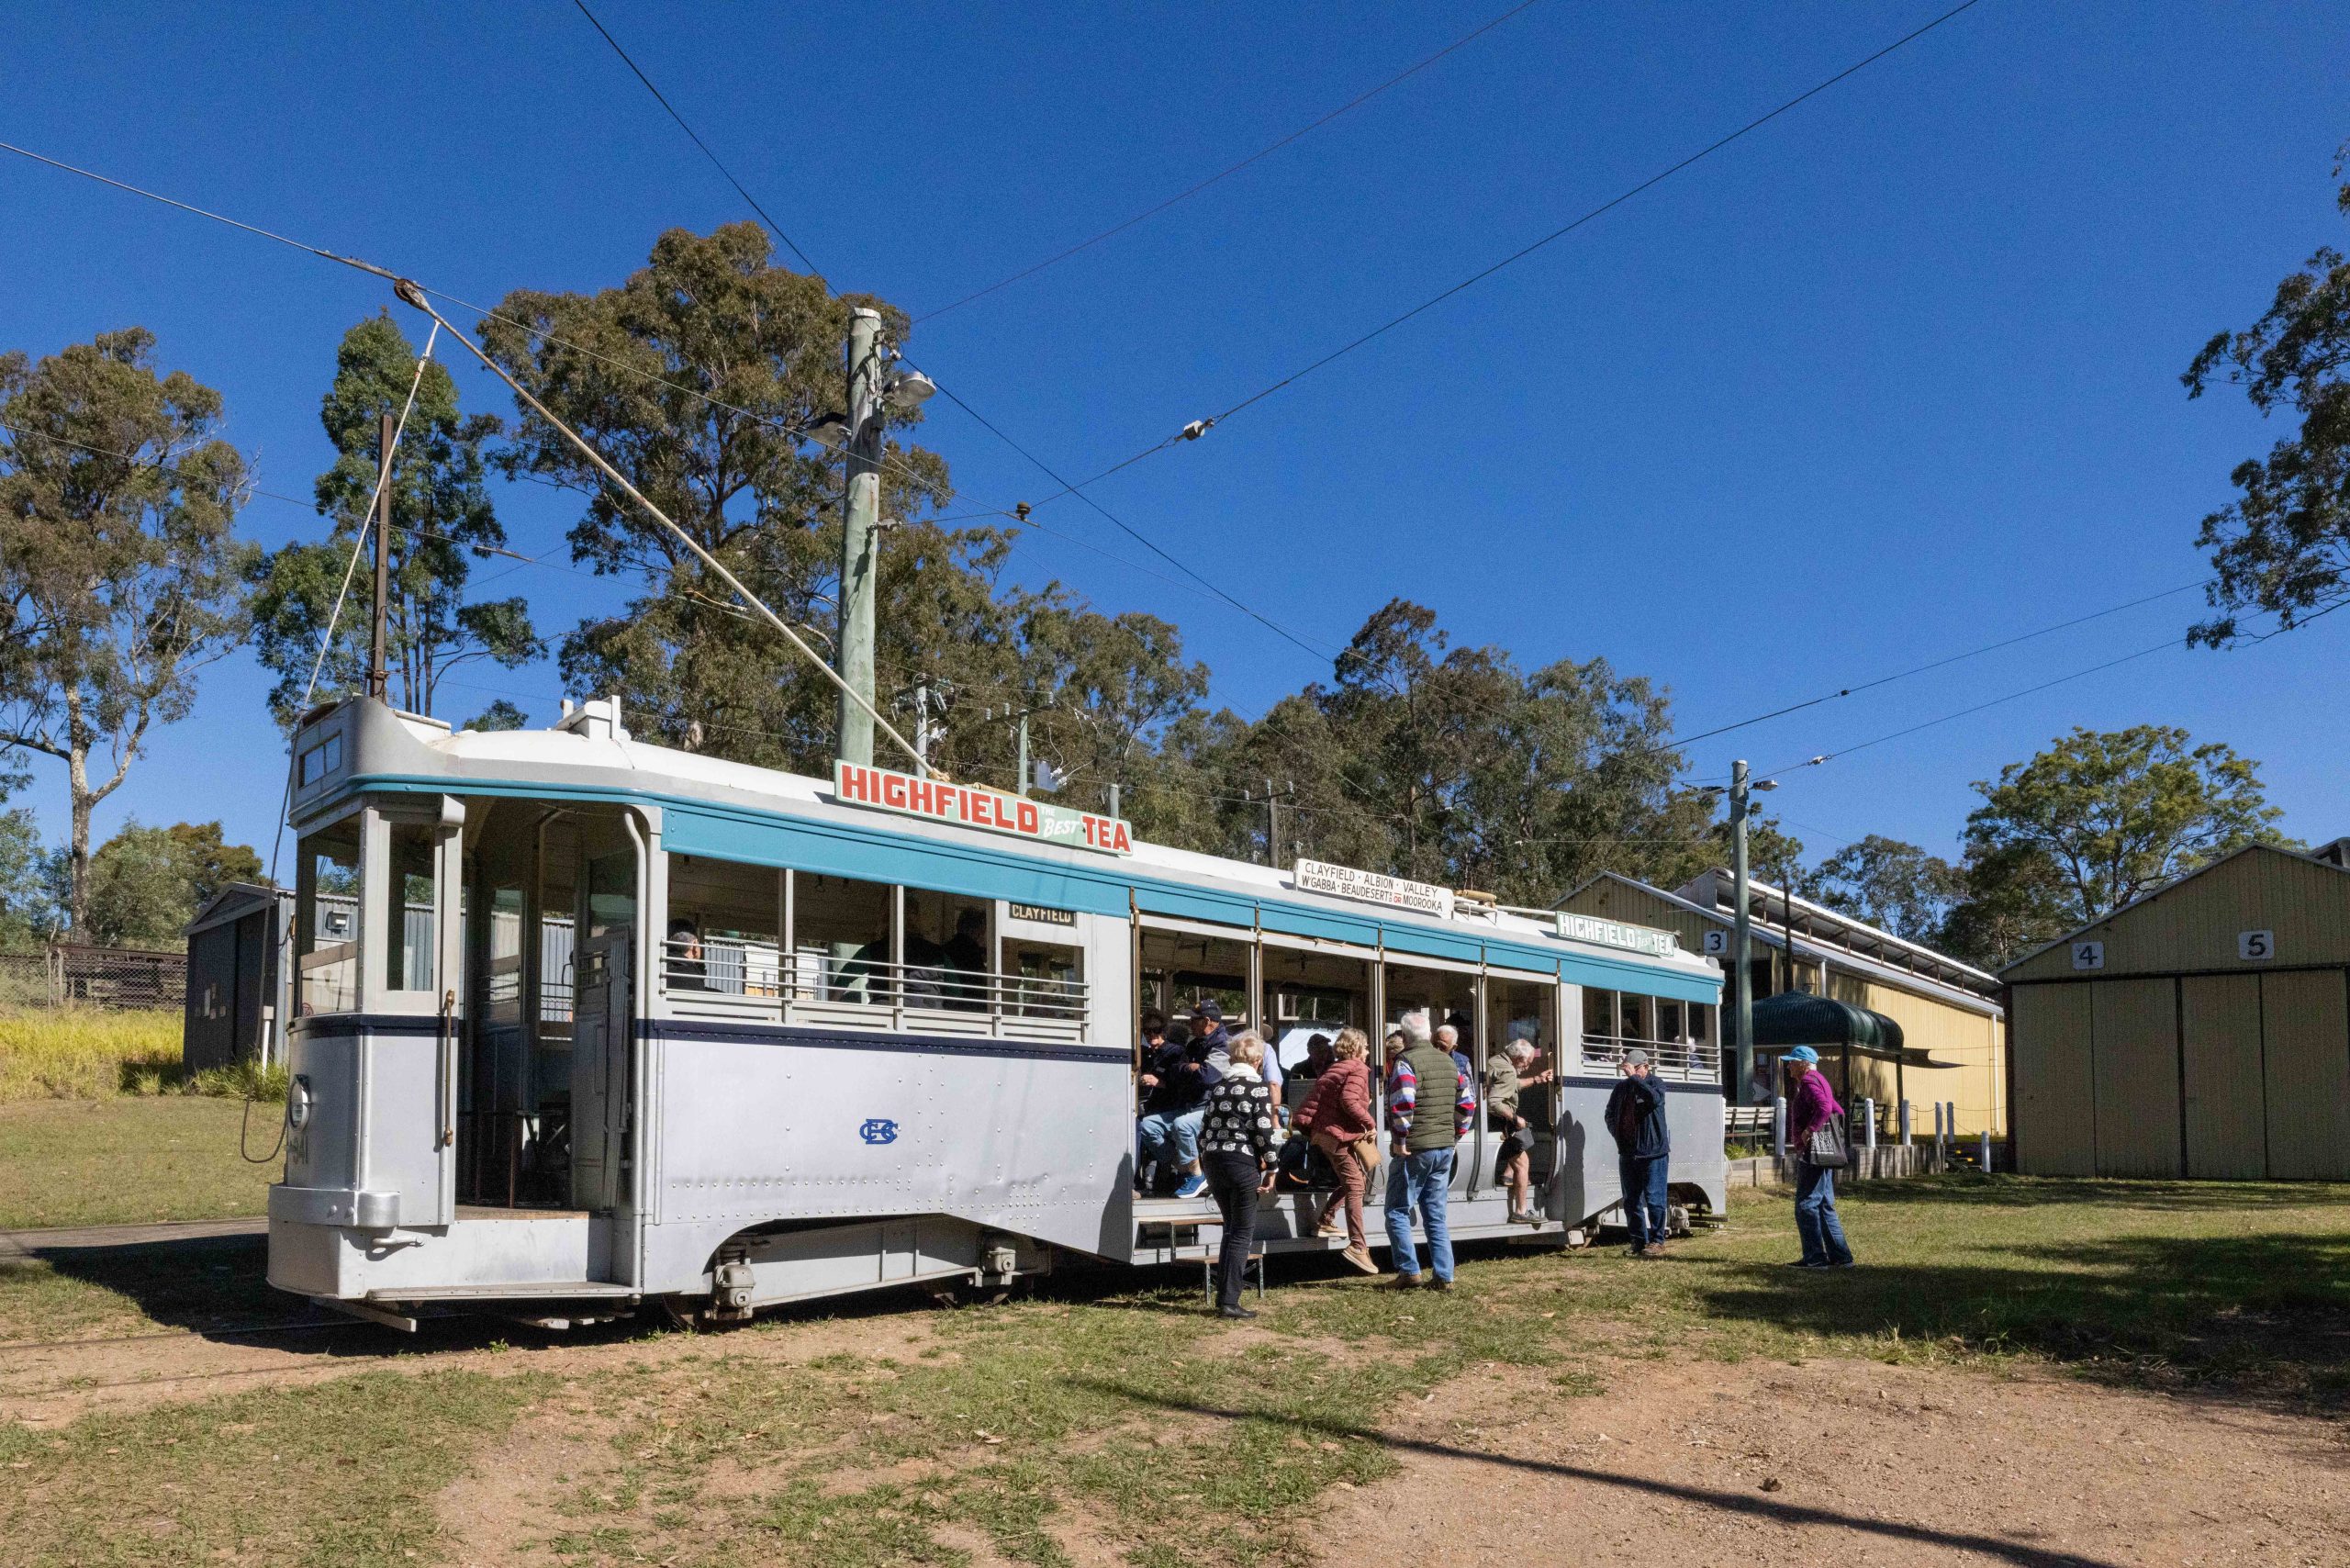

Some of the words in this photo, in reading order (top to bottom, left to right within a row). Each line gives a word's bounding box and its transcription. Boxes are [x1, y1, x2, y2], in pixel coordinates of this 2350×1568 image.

[840, 764, 1039, 834] HIGHFIELD
[1081, 814, 1132, 853] TEA
[1041, 806, 1056, 816] THE
[1044, 817, 1080, 837] BEST
[1305, 862, 1355, 881] CLAYFIELD
[1364, 874, 1393, 891] ALBION
[1403, 881, 1438, 898] VALLEY
[1341, 882, 1389, 902] BEAUDESERT
[1403, 894, 1443, 912] MOOROOKA
[1013, 904, 1071, 924] CLAYFIELD
[1559, 913, 1636, 948] HIGHFIELD
[1651, 933, 1673, 956] TEA
[1710, 933, 1723, 951] 3
[2247, 934, 2266, 957] 5
[2078, 945, 2098, 966] 4
